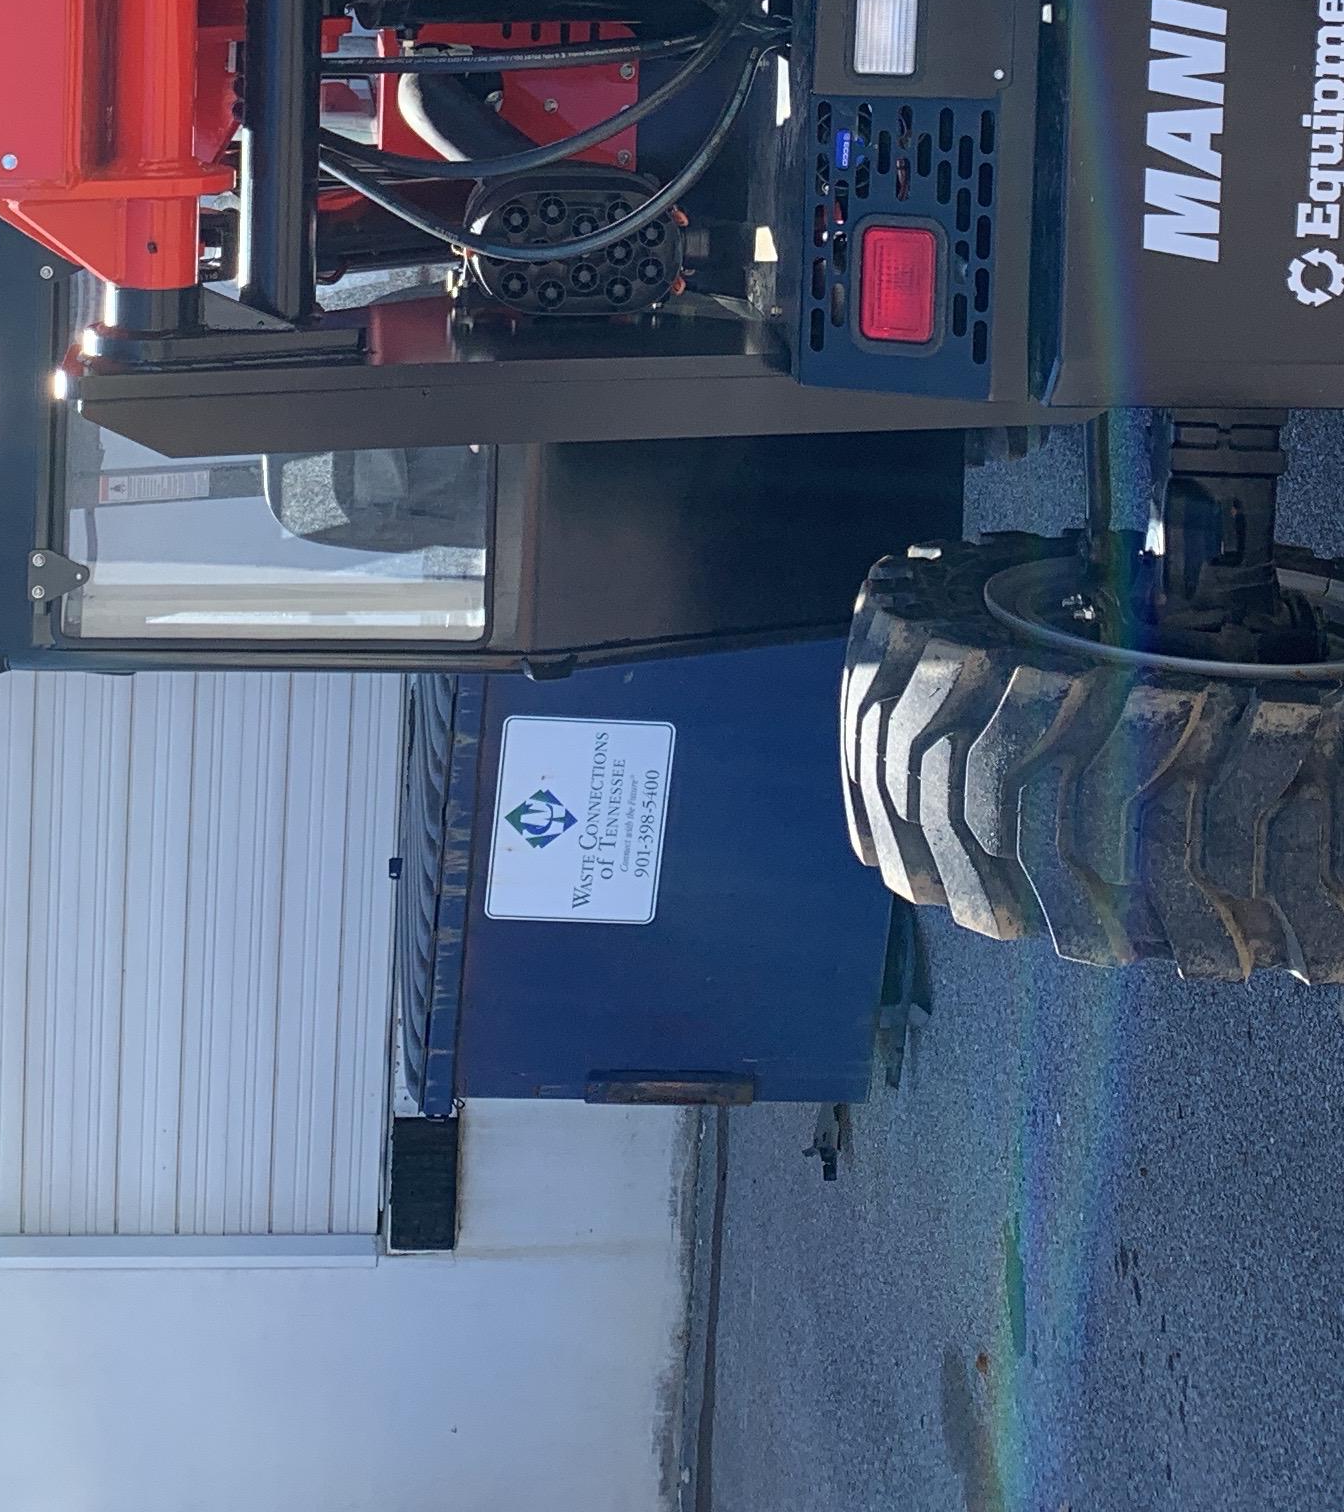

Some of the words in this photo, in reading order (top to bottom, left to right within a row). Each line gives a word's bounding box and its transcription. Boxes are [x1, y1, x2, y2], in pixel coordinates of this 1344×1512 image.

[578, 732, 610, 851] CONNECTIONS
[598, 759, 626, 852] TENNESSEE
[634, 769, 660, 878] 901-398-5400
[571, 855, 597, 909] WASTE
[596, 857, 615, 880] of
